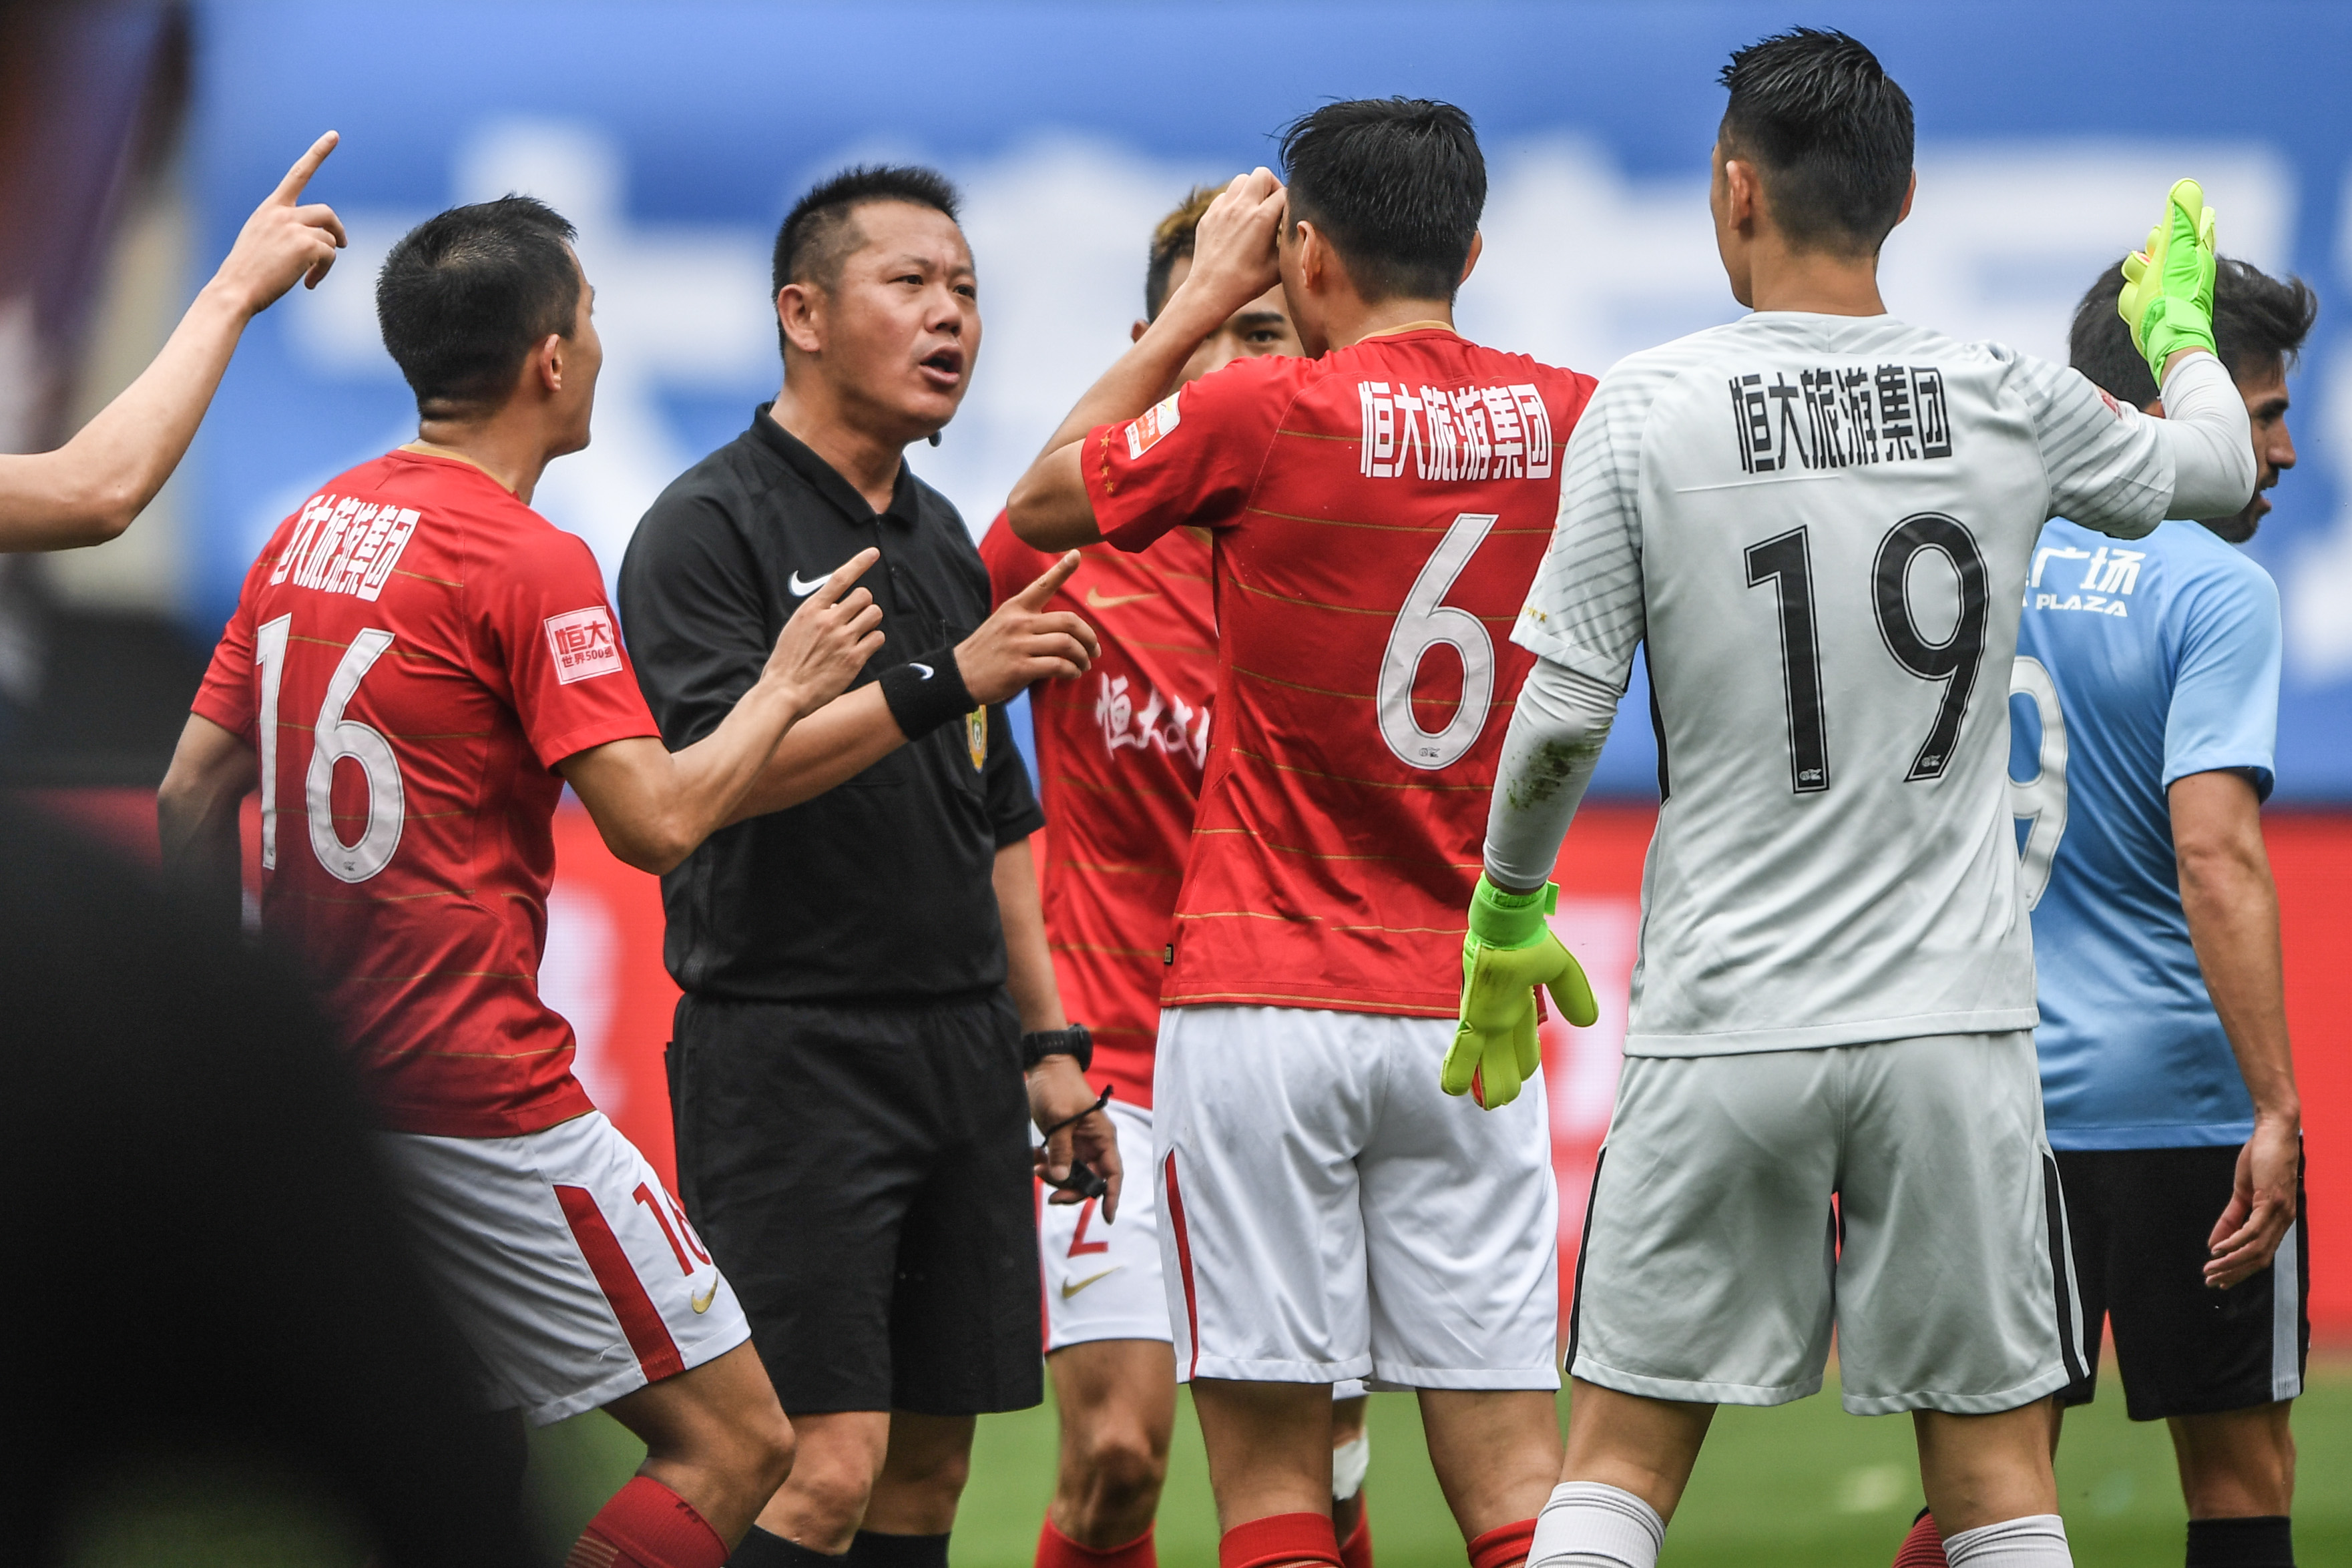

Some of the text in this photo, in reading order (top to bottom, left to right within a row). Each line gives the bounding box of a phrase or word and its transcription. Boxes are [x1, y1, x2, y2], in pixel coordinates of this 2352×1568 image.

[1358, 381, 1552, 481] 恒大旅游集团
[1728, 364, 1952, 474] 恒大旅游集团
[2026, 547, 2146, 595] 广场
[2036, 593, 2128, 617] PLAZA
[554, 620, 611, 655] 恒大
[1377, 513, 1497, 770] 6
[1744, 512, 1989, 793] 19
[257, 613, 405, 883] 16
